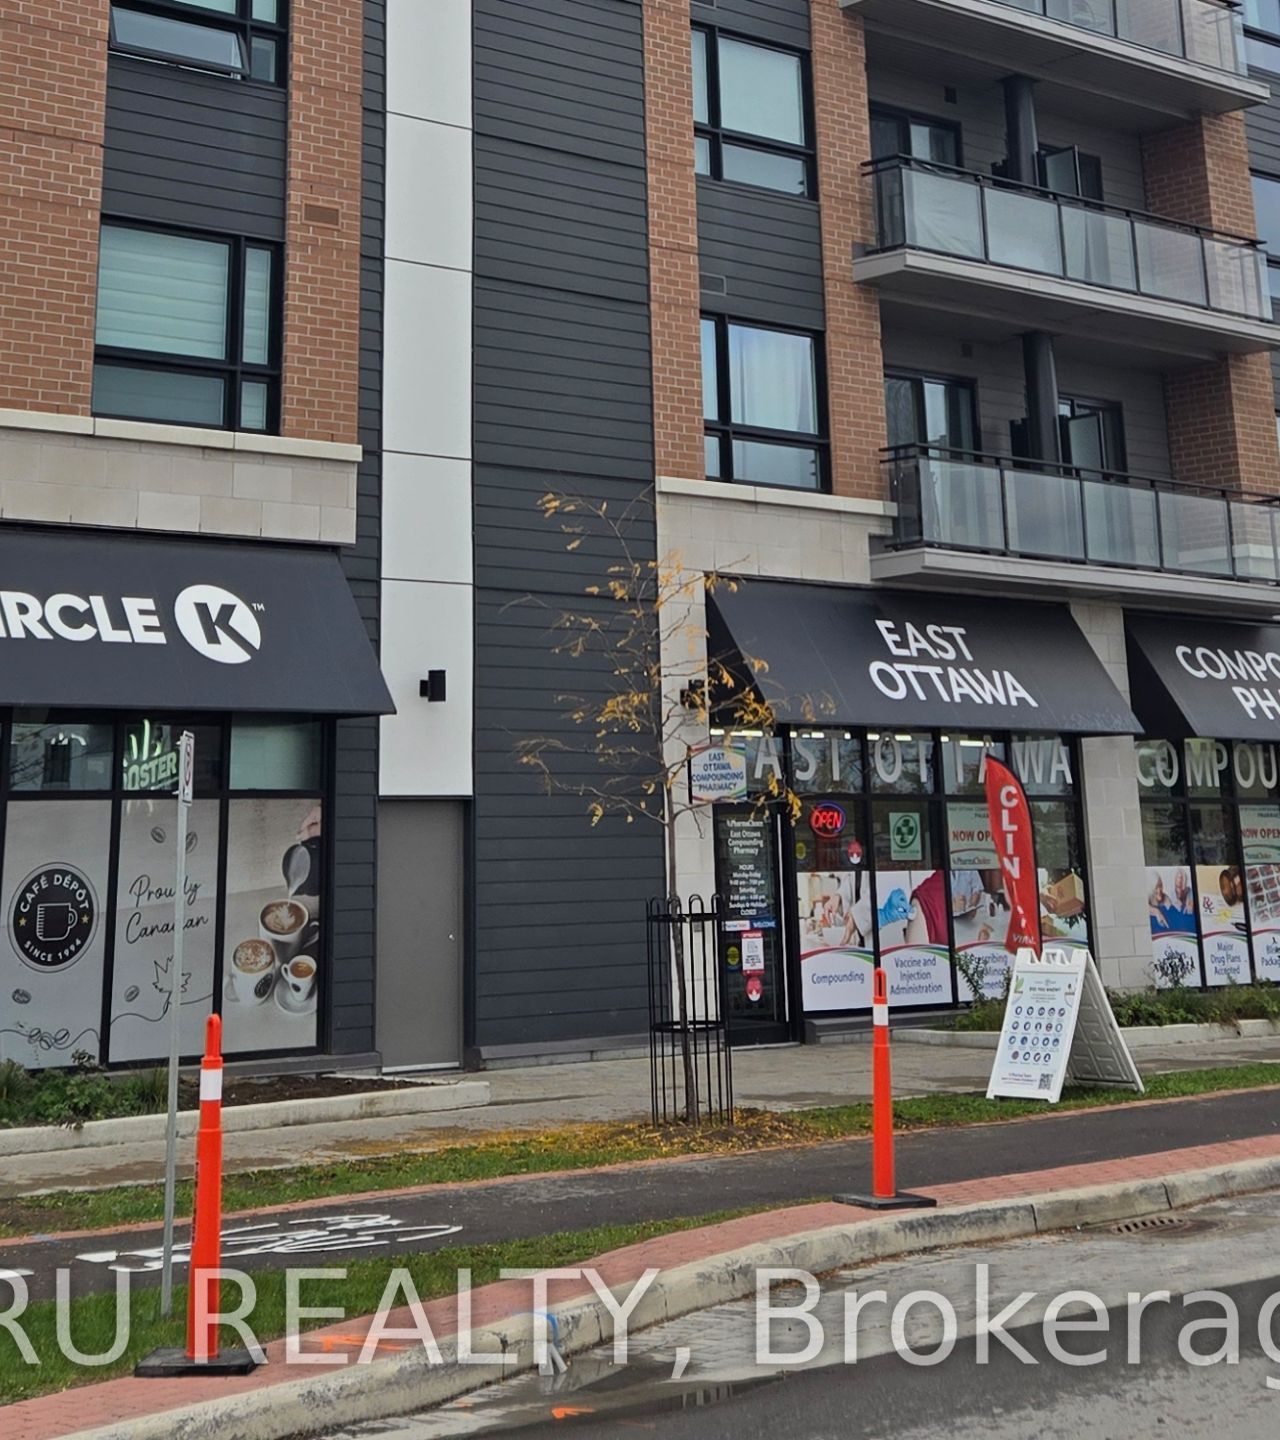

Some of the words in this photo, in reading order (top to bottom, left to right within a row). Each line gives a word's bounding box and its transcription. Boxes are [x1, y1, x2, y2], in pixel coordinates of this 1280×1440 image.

[188, 596, 261, 661] K
[874, 619, 974, 661] EAST
[868, 660, 1039, 708] OTTAWA
[708, 752, 725, 761] EAST
[702, 762, 732, 772] OTTAWA
[691, 771, 744, 782] COMPOUNDING
[698, 782, 737, 792] PHARMACY
[813, 811, 842, 829] OPEN
[952, 830, 975, 842] NOW
[977, 830, 994, 842] OP
[1241, 828, 1259, 839] NOW
[20, 876, 49, 913] CAFÉ
[53, 873, 90, 910] DÉPÔT
[128, 874, 202, 908] Prouly
[125, 912, 209, 945] Canaan
[24, 939, 53, 962] SINCE
[57, 937, 83, 960] 1994
[1216, 941, 1234, 952] Major
[894, 958, 922, 968] Vaccine
[922, 956, 937, 967] and
[1210, 954, 1226, 966] Drug
[1226, 953, 1241, 963] Plans
[811, 970, 865, 986] Compounding
[900, 970, 932, 985] Injection
[1214, 965, 1241, 977] Accepted
[890, 982, 943, 996] Administration
